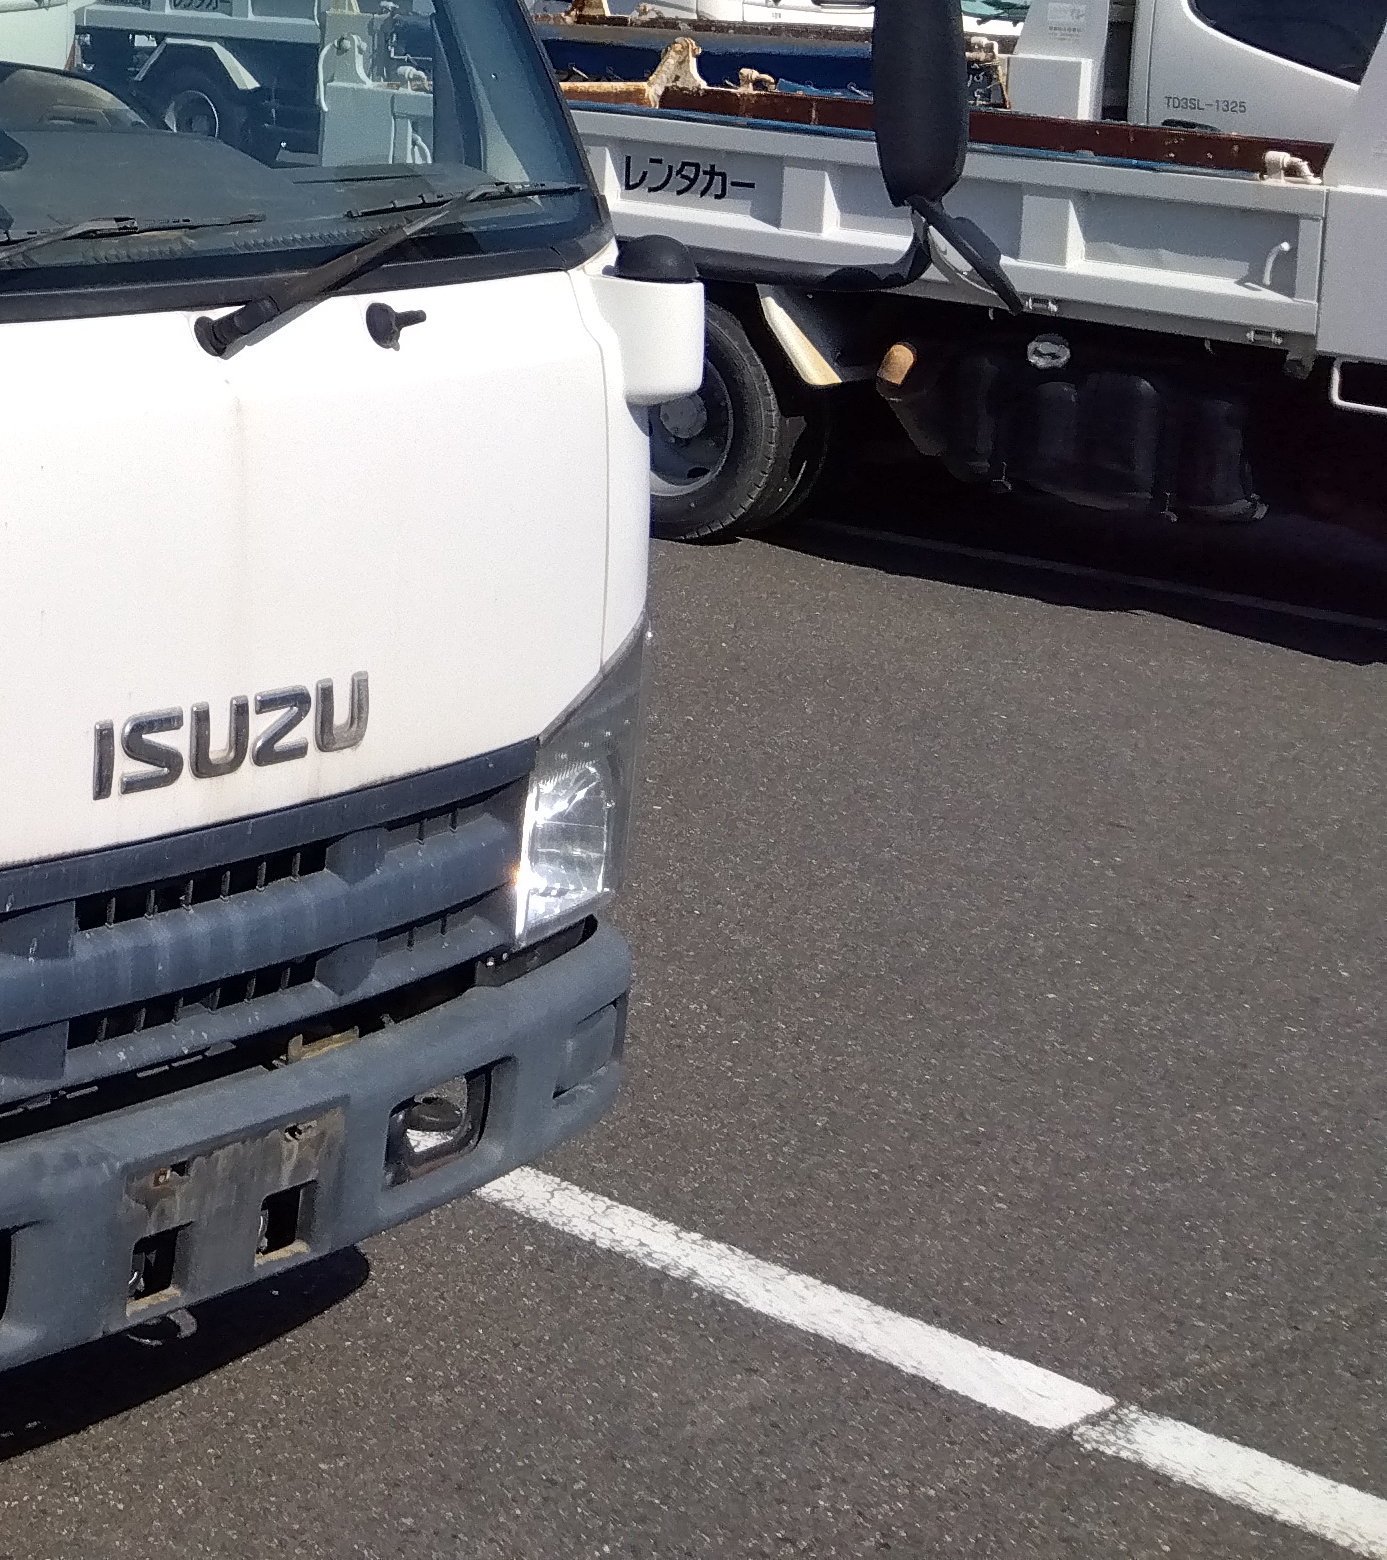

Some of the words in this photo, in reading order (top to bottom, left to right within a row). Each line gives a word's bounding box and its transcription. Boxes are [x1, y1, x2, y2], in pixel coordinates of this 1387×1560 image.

[1164, 95, 1247, 114] TD3SL-1325
[624, 155, 756, 200] レンタカー
[91, 670, 370, 801] ISUZU
